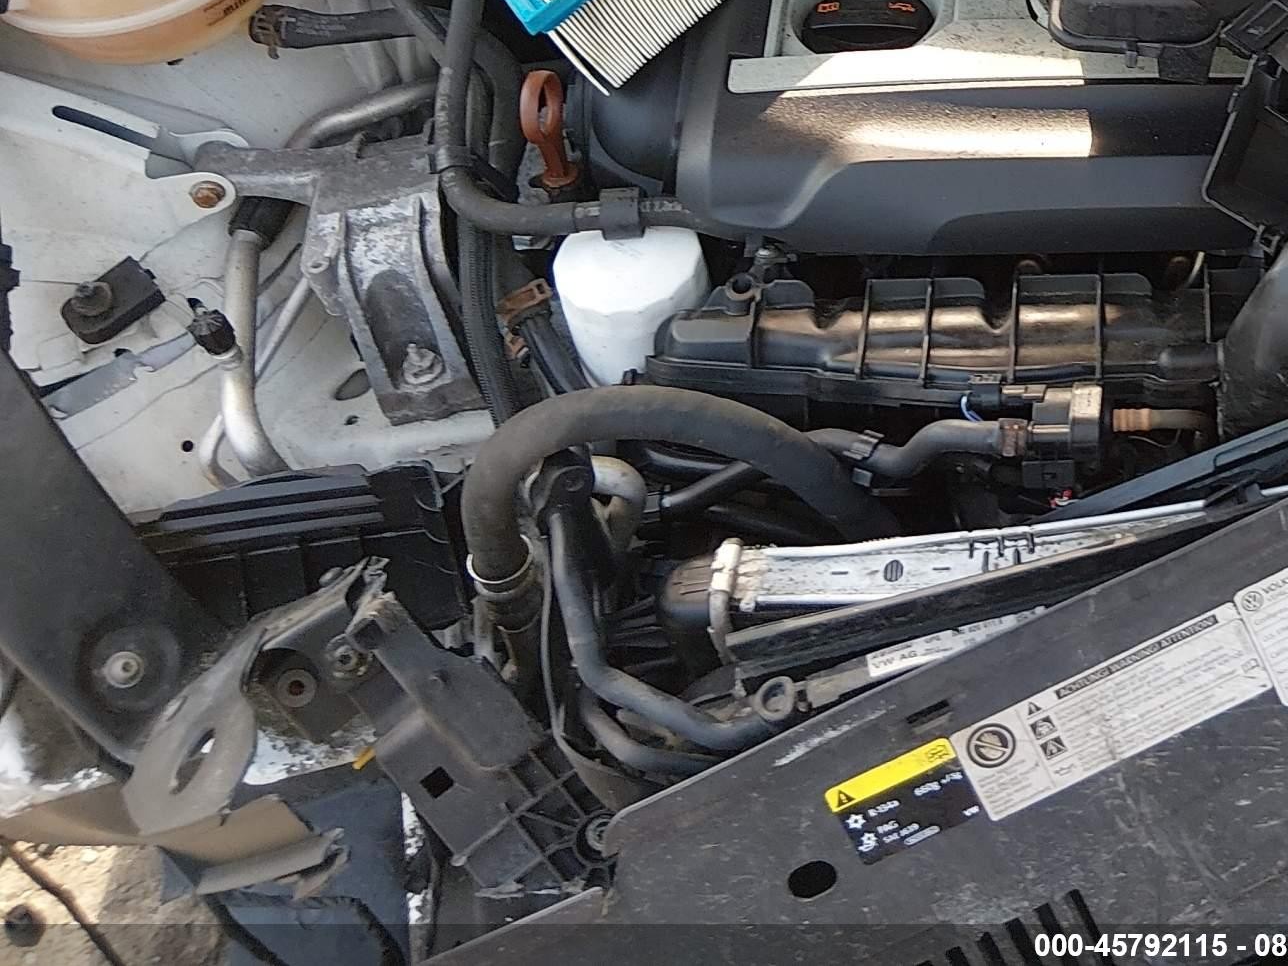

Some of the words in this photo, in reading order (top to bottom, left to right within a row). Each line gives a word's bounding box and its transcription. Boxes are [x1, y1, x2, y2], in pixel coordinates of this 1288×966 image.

[871, 657, 894, 669] VW
[898, 649, 918, 661] AG
[1056, 666, 1109, 699] ACHTUNG!
[1109, 641, 1161, 673] WARNING!
[1159, 614, 1218, 649] ATTENTION!
